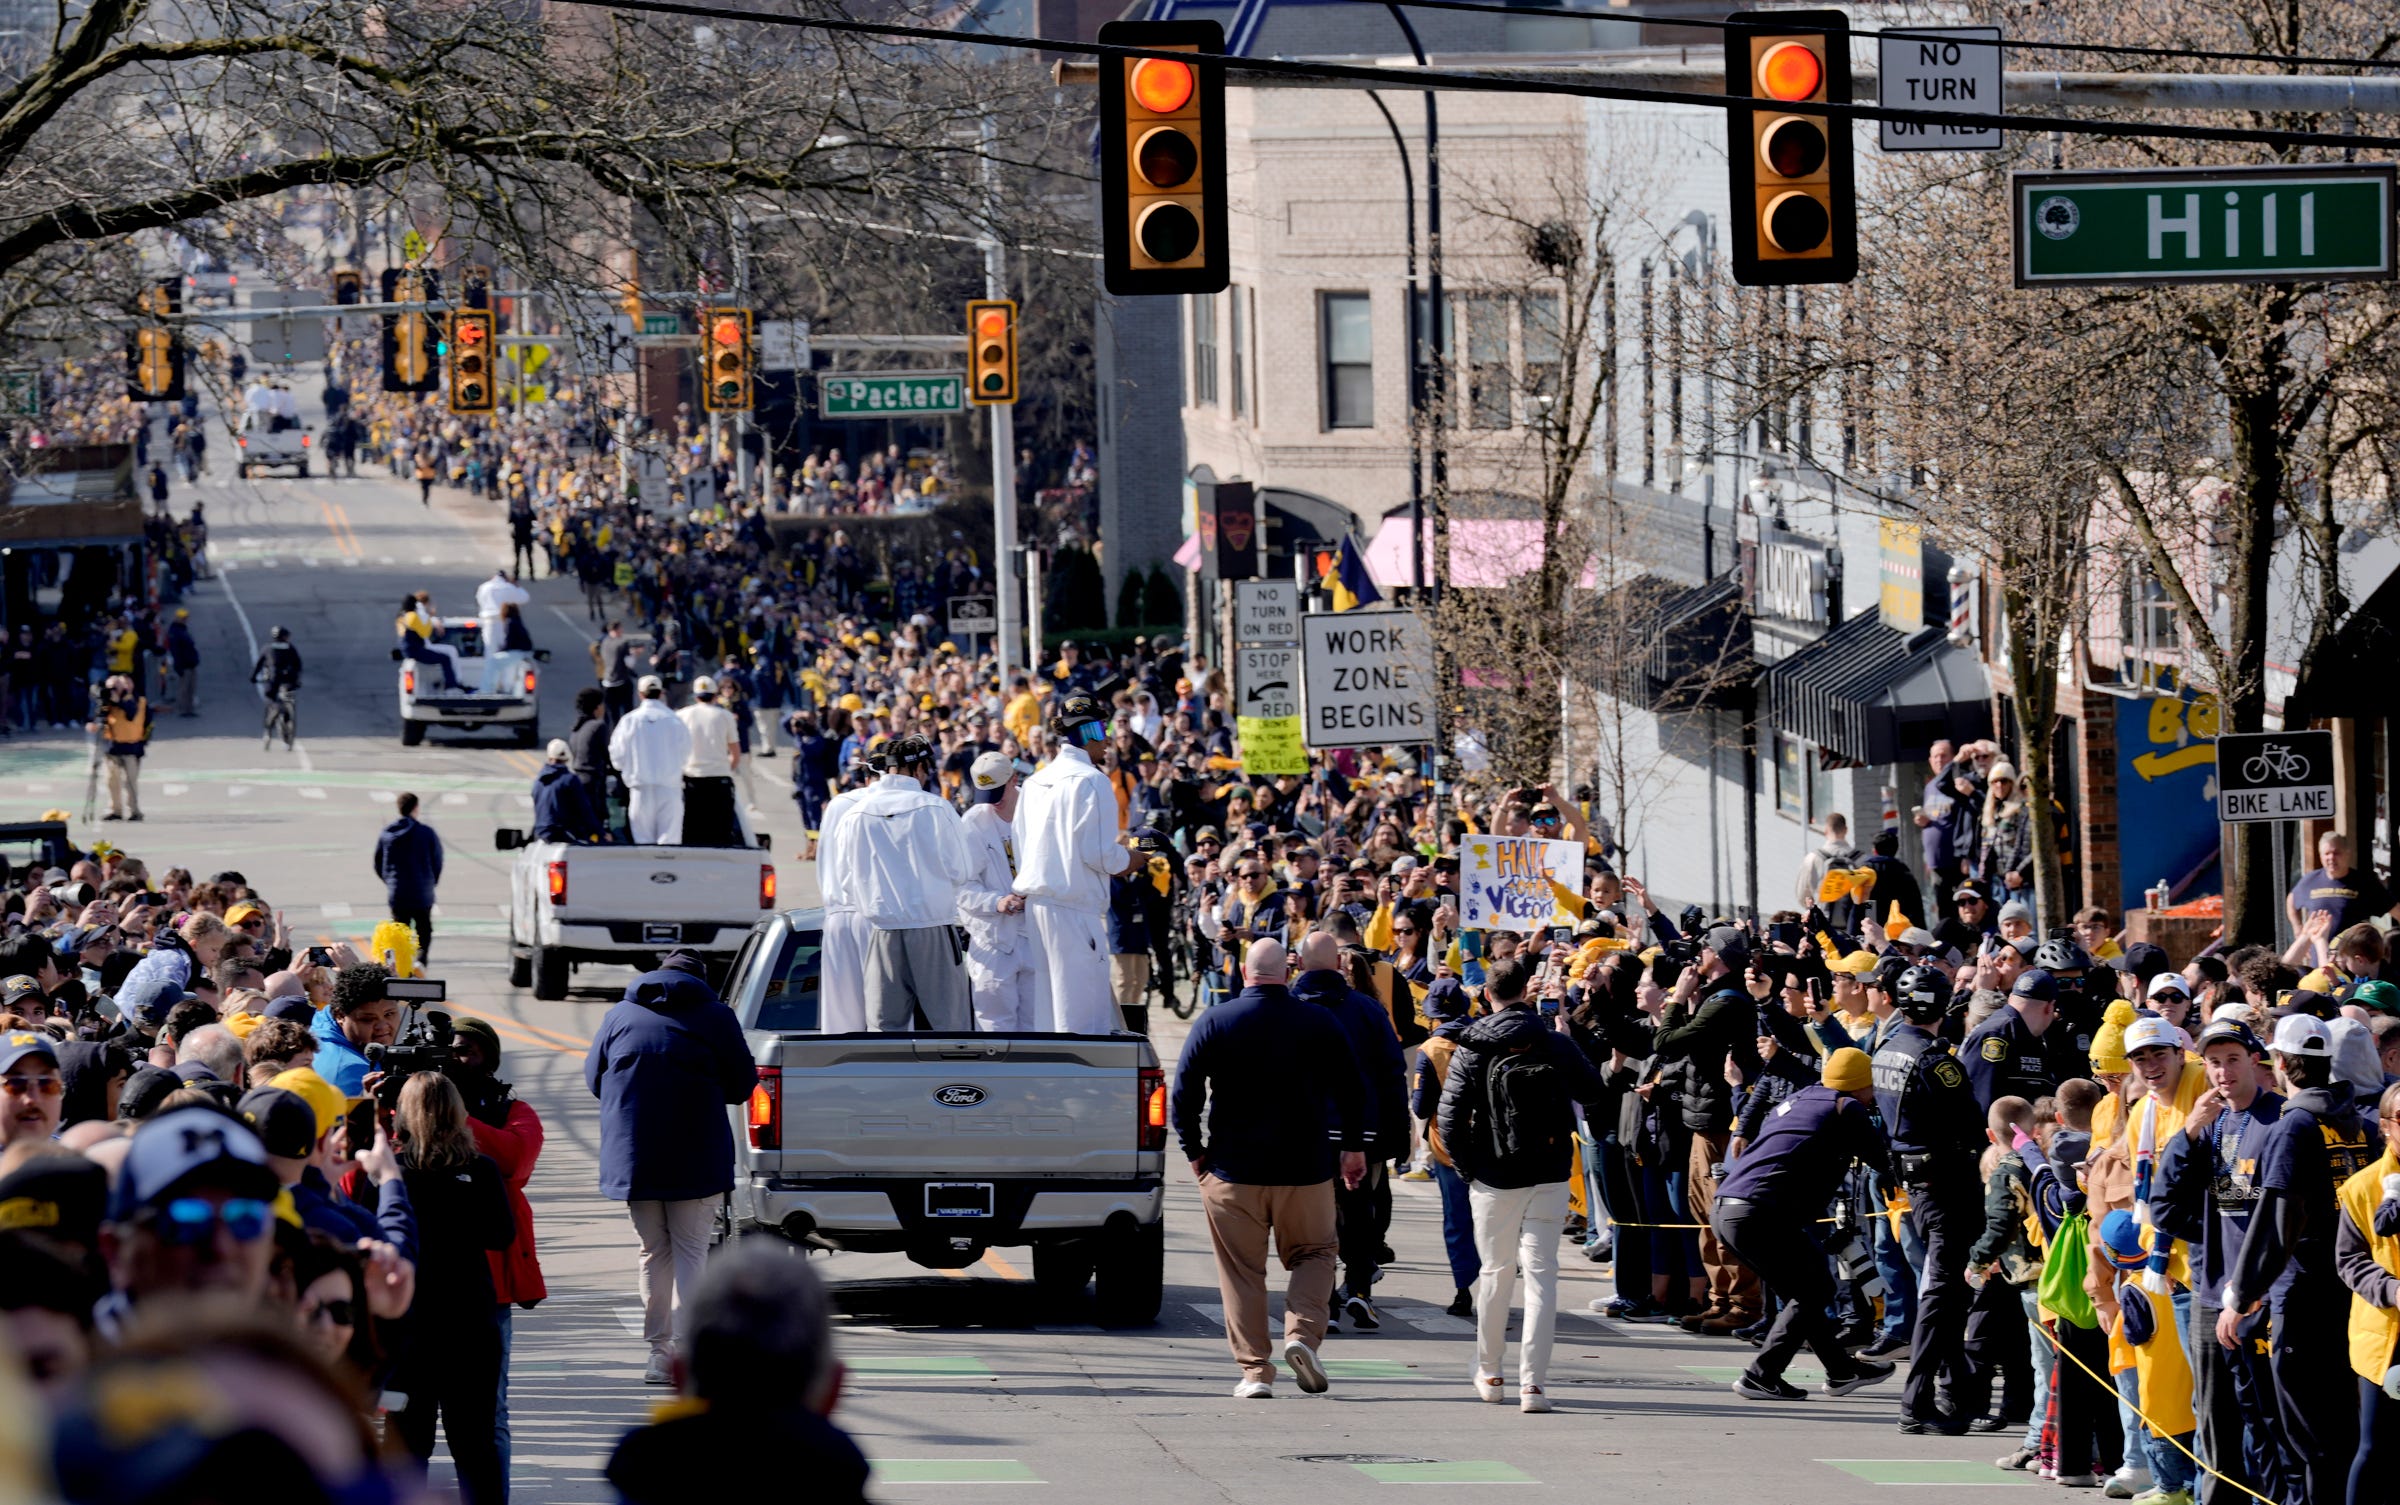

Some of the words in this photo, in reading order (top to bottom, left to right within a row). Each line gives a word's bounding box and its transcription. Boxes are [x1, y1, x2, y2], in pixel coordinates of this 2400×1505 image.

[1920, 43, 1961, 66] NO
[1906, 78, 1976, 101] TURN
[2147, 191, 2315, 259] Hill
[851, 381, 956, 409] Packard
[1760, 544, 1814, 622] LIQUOR
[1257, 589, 1279, 601] NO
[1251, 606, 1286, 618] TURN
[1243, 624, 1261, 636] ON
[1268, 623, 1294, 635] RED
[1325, 628, 1406, 655] WORK
[1248, 653, 1291, 668] STOP
[1256, 671, 1283, 680] HERE
[1333, 665, 1409, 692] ZONE
[1271, 691, 1285, 700] ON
[1261, 703, 1294, 717] RED
[1321, 702, 1424, 730] BEGINS
[2227, 793, 2270, 815] BIKE
[2280, 790, 2329, 812] LANE
[1496, 839, 1556, 880] HAIL
[2019, 1056, 2042, 1065] STATE
[943, 1088, 977, 1103] Ford
[848, 1114, 1075, 1136] F-150
[937, 1208, 982, 1216] VARSITY
